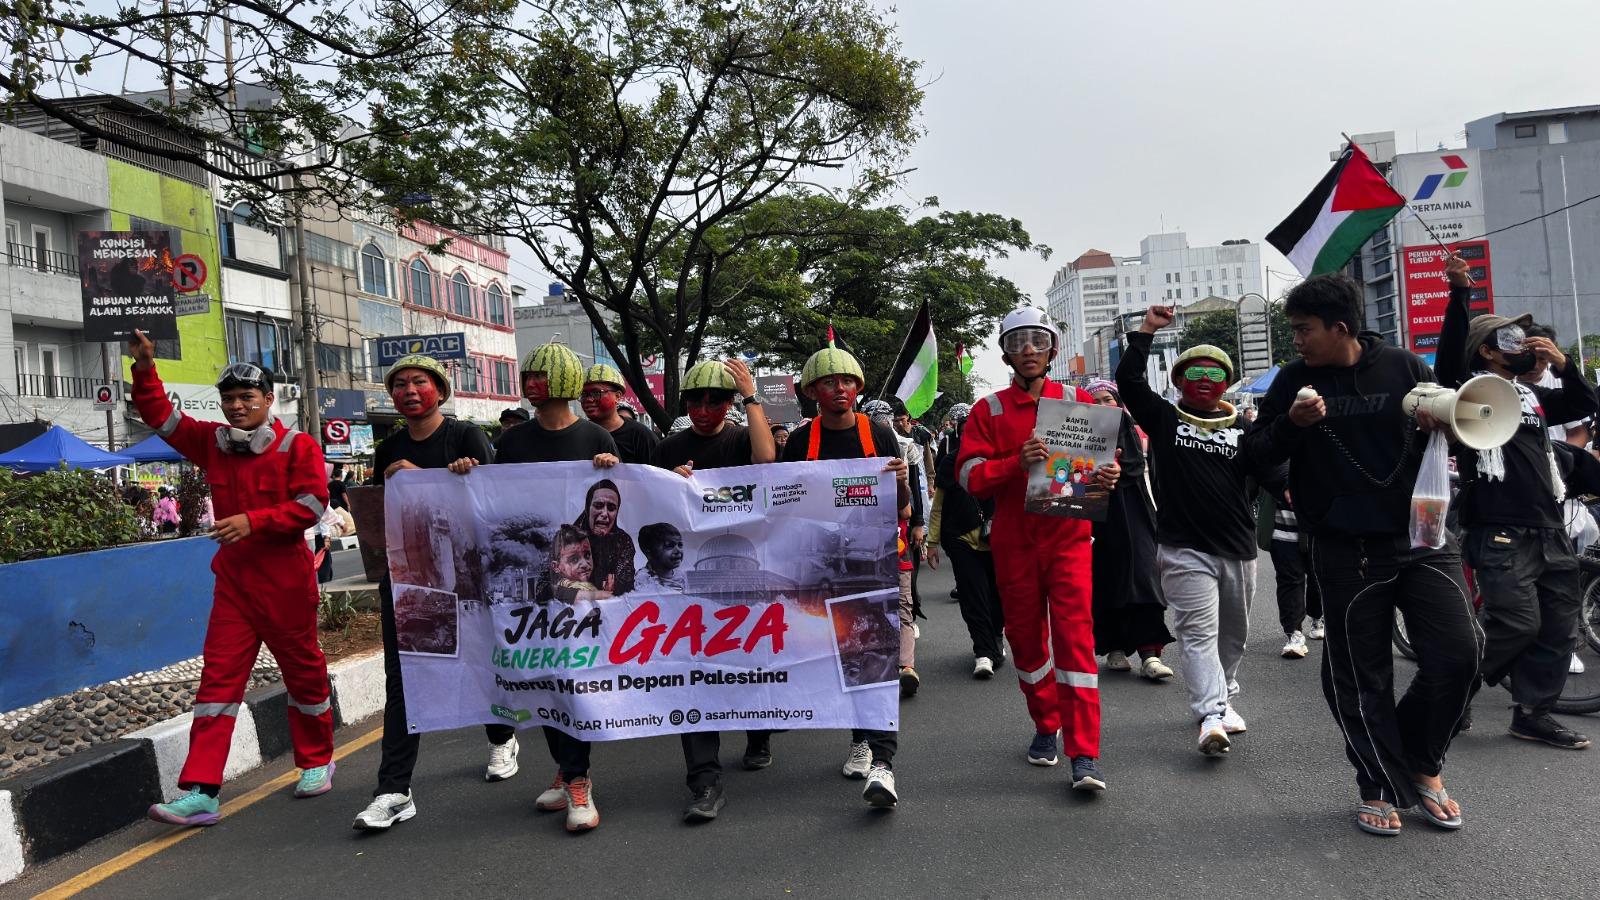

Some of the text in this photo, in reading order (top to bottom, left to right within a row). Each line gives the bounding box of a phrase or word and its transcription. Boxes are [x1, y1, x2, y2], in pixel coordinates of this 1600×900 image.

[1411, 200, 1472, 213] PERTAMINA
[100, 239, 145, 248] KONDISI
[93, 248, 158, 259] MENDESAK
[1409, 256, 1434, 264] TURBO
[93, 295, 169, 306] RIBUAN NYAWA
[89, 306, 174, 316] ALAMI SESAKKK
[1412, 315, 1446, 324] DEXLITE
[382, 335, 461, 358] INOAC
[1065, 416, 1089, 426] BANTU
[1061, 424, 1093, 434] SAUDARA
[1084, 444, 1107, 452] HUTAN
[1174, 434, 1238, 459] humanity
[833, 477, 877, 487] SELAMANYA
[771, 483, 803, 492] Lembaga
[848, 486, 870, 496] JAGA
[702, 483, 757, 504] asar
[771, 489, 807, 499] Amil Zakat
[772, 497, 801, 506] Nasional
[835, 495, 878, 506] PALESTINA
[702, 502, 753, 513] humanity
[504, 600, 789, 665] JAGA GAZA
[491, 644, 600, 669] GENERASI
[495, 667, 788, 695] Penerus Masa Depan Palestina
[605, 714, 664, 729] Humanity
[704, 707, 814, 721] asarhumanity.org
